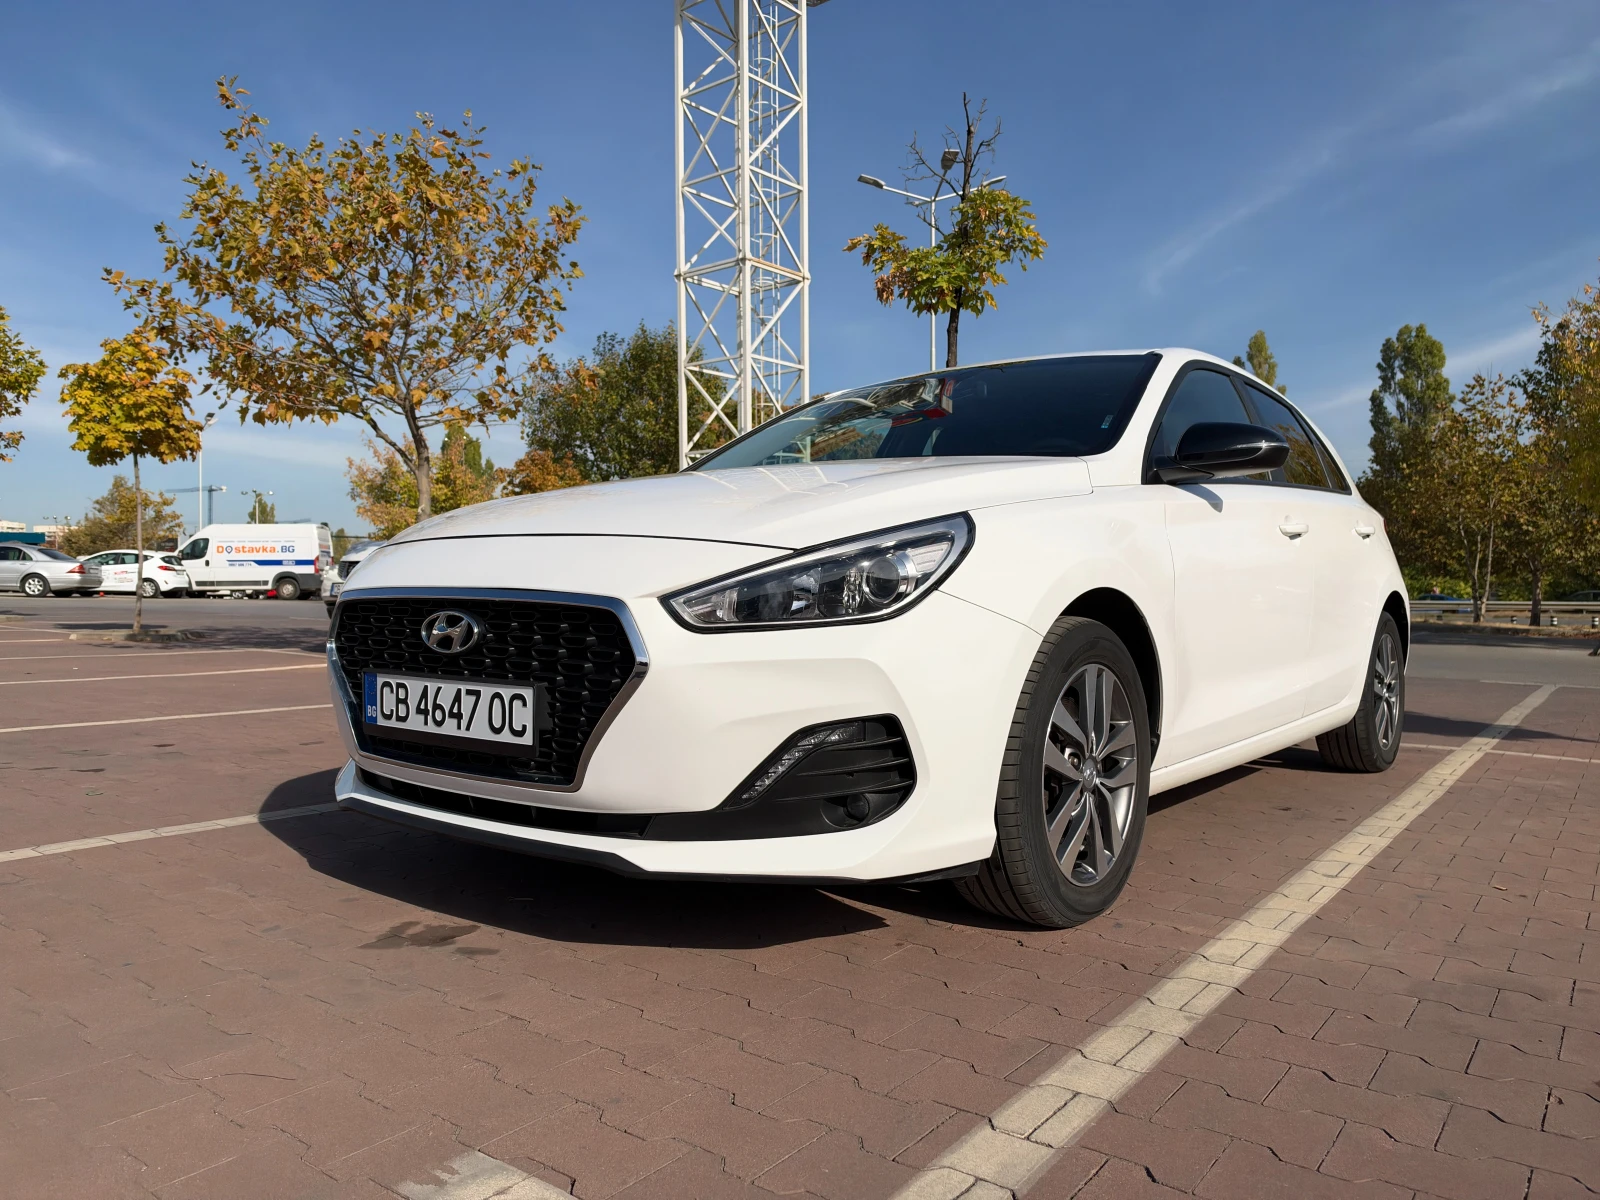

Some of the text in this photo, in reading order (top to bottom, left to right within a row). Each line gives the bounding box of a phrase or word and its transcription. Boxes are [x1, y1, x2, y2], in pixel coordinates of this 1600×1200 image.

[367, 705, 377, 717] BG
[380, 681, 528, 738] CB 4647 OC
